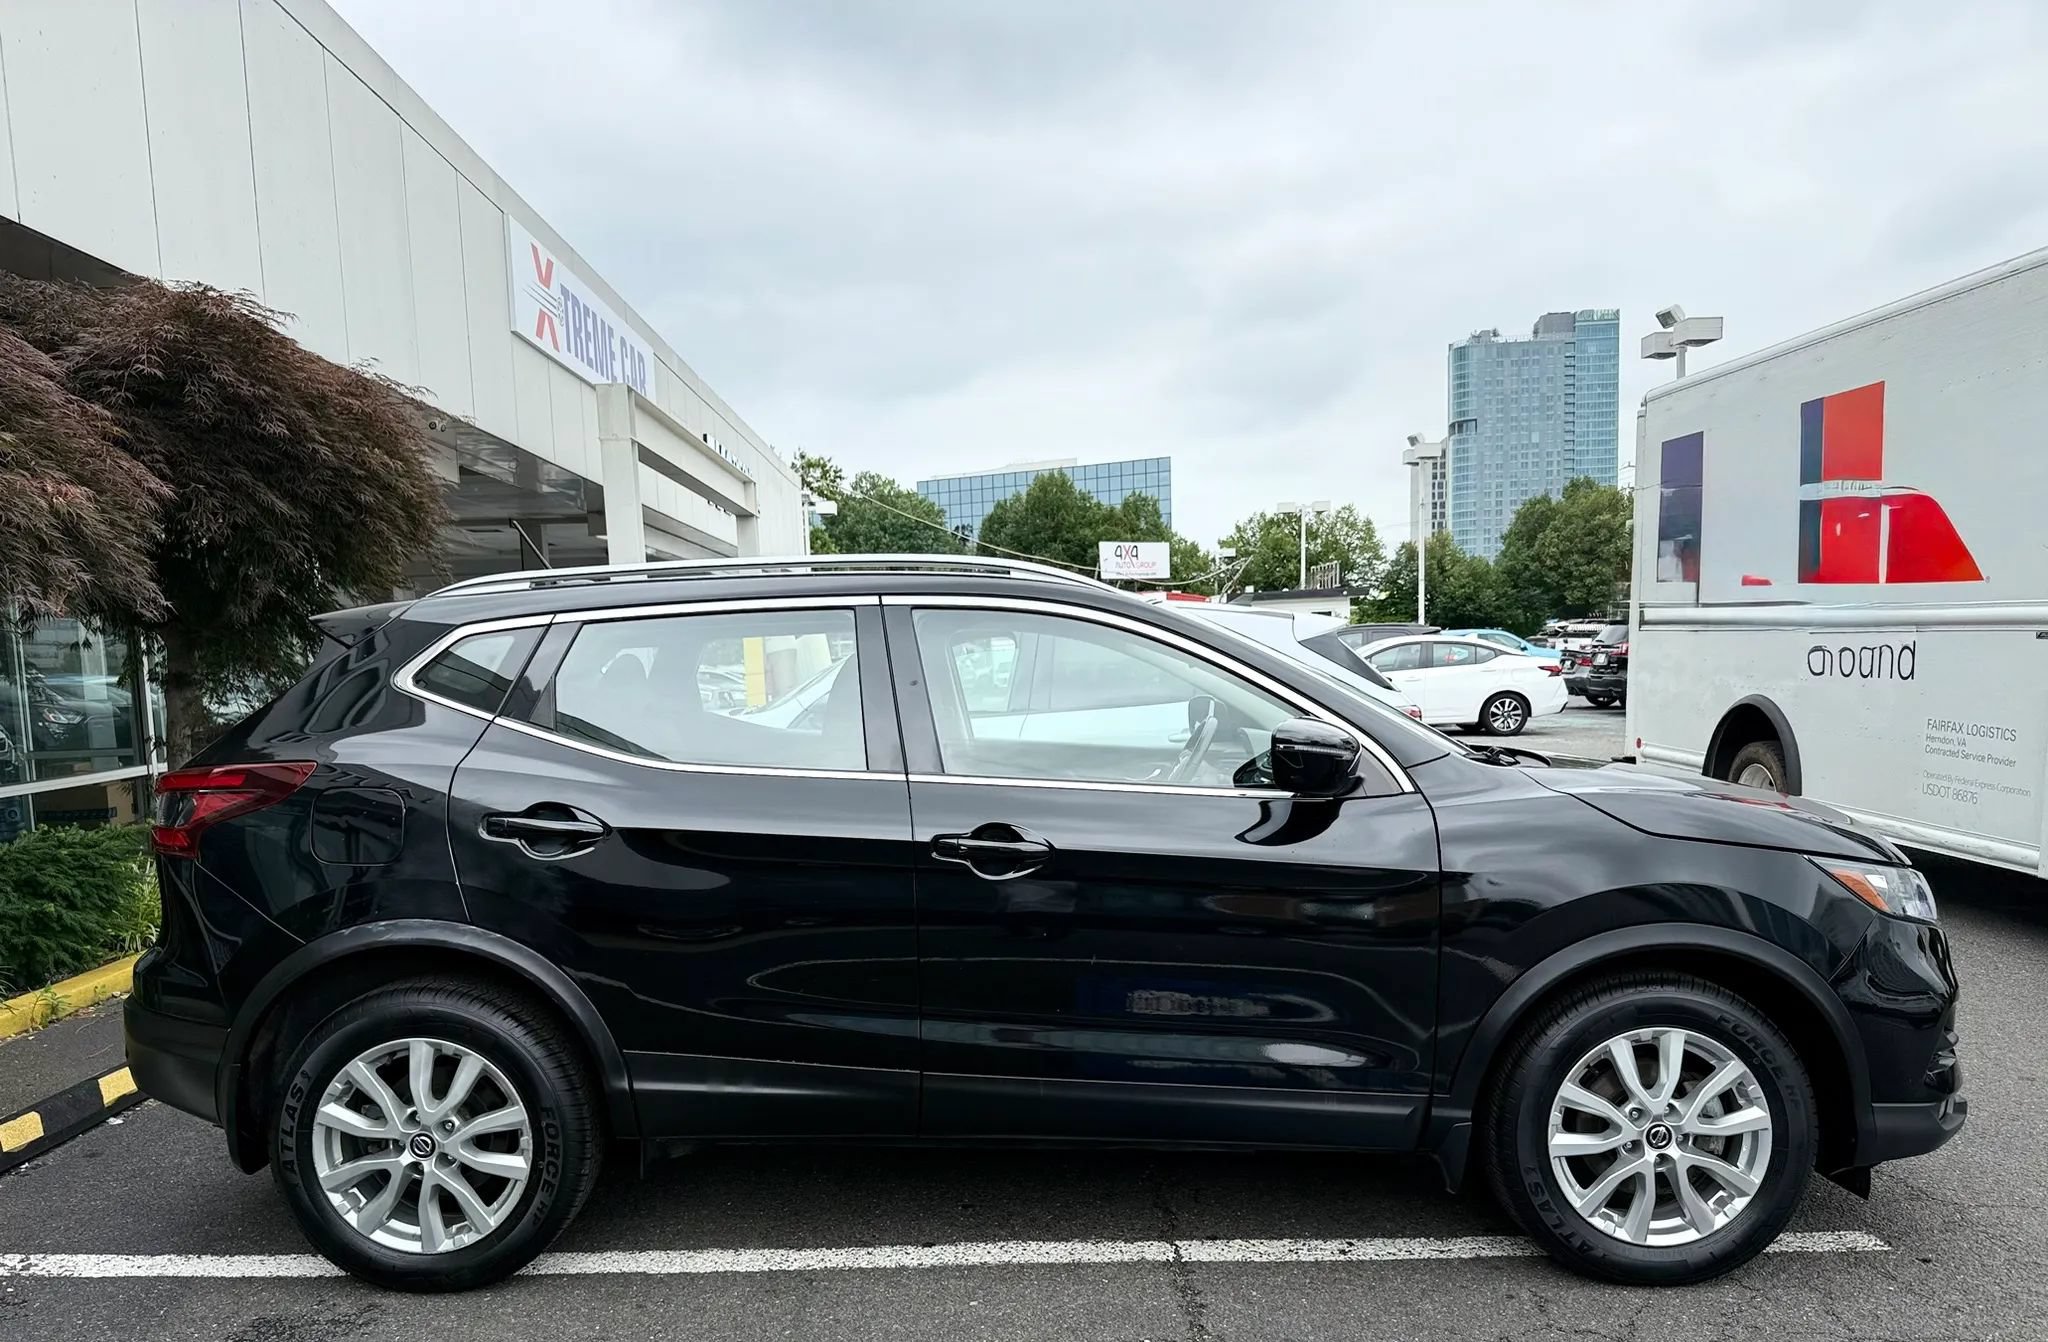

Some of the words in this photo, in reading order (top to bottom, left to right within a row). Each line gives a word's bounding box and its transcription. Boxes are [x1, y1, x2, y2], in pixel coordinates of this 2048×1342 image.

[619, 335, 647, 397] CAR
[1927, 718, 1965, 735] FAIRFAX
[1966, 723, 2017, 742] LOGISTICS
[1957, 738, 1967, 747] VA
[1924, 744, 1960, 758] Contracted
[1960, 749, 1986, 763] Service
[1986, 753, 2016, 767] Provider
[1922, 783, 1951, 799] USDOT
[1996, 783, 2031, 797] Corporation
[280, 1083, 304, 1175] ATLAS
